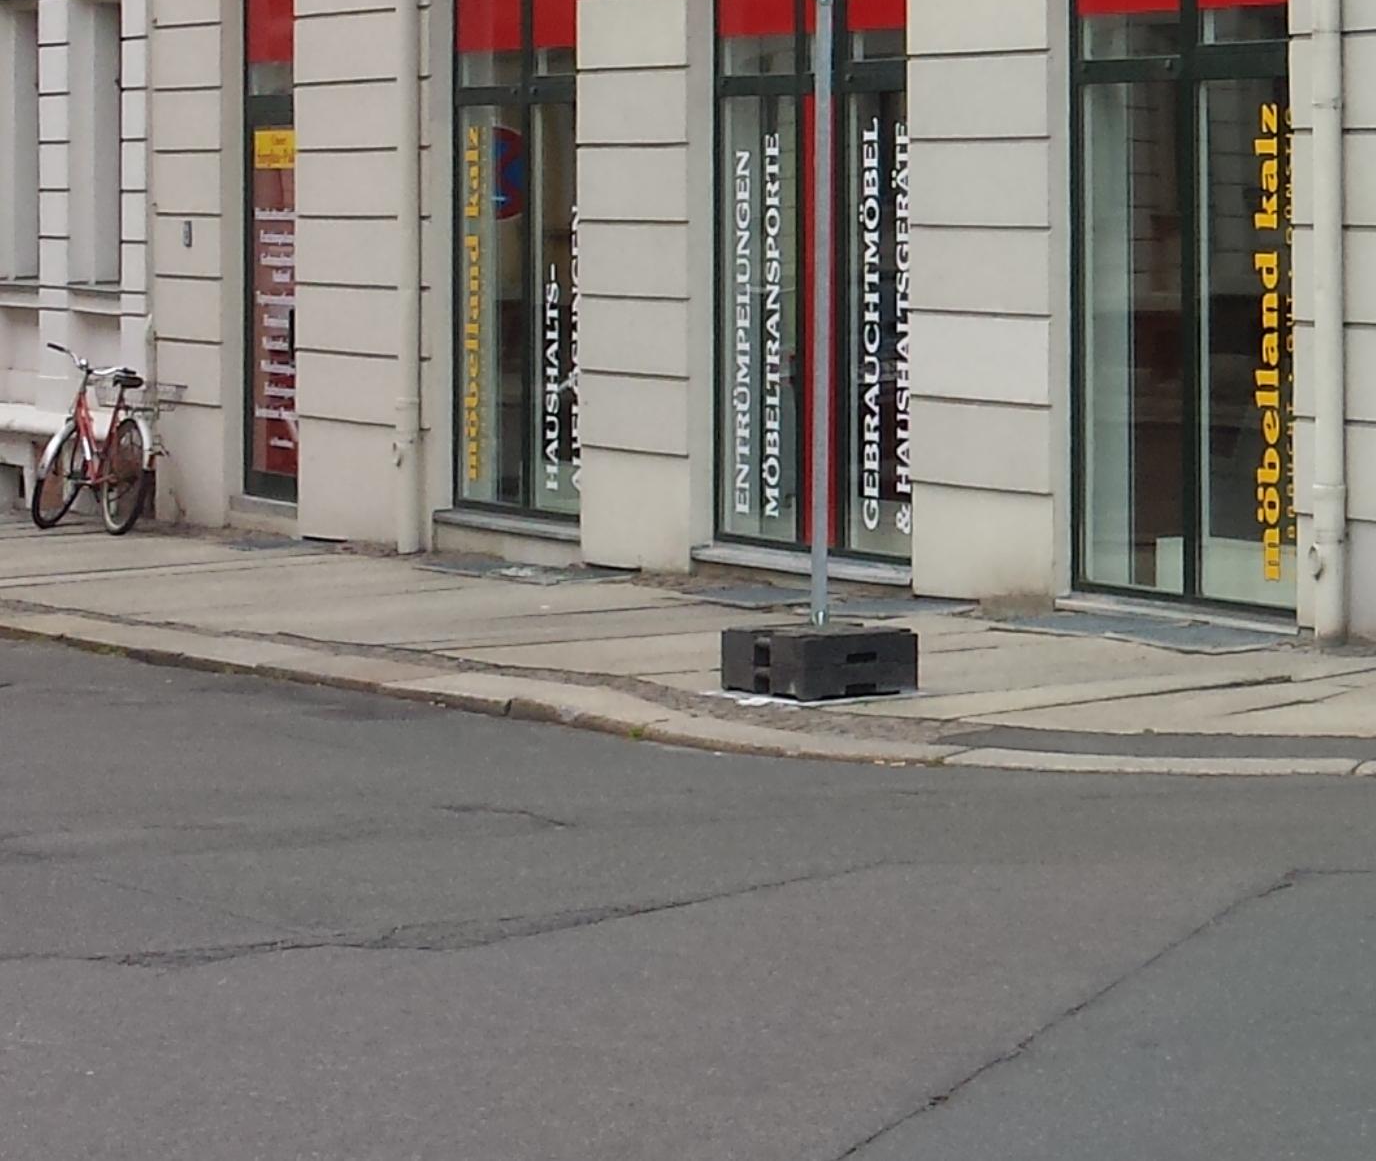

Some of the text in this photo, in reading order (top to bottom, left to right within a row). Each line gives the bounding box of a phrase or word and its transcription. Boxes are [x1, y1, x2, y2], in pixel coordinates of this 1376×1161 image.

[545, 263, 560, 490] HAUSHALTS-
[733, 150, 751, 514] ENTRÜMPELUNGEN
[762, 133, 781, 517] MÖBELTRANSPORTE
[859, 117, 880, 530] GEBRAUCHTMÖBEL
[891, 122, 911, 534] & HAUSHALTSGERÄTE
[1255, 103, 1280, 581] möbelland kalz
